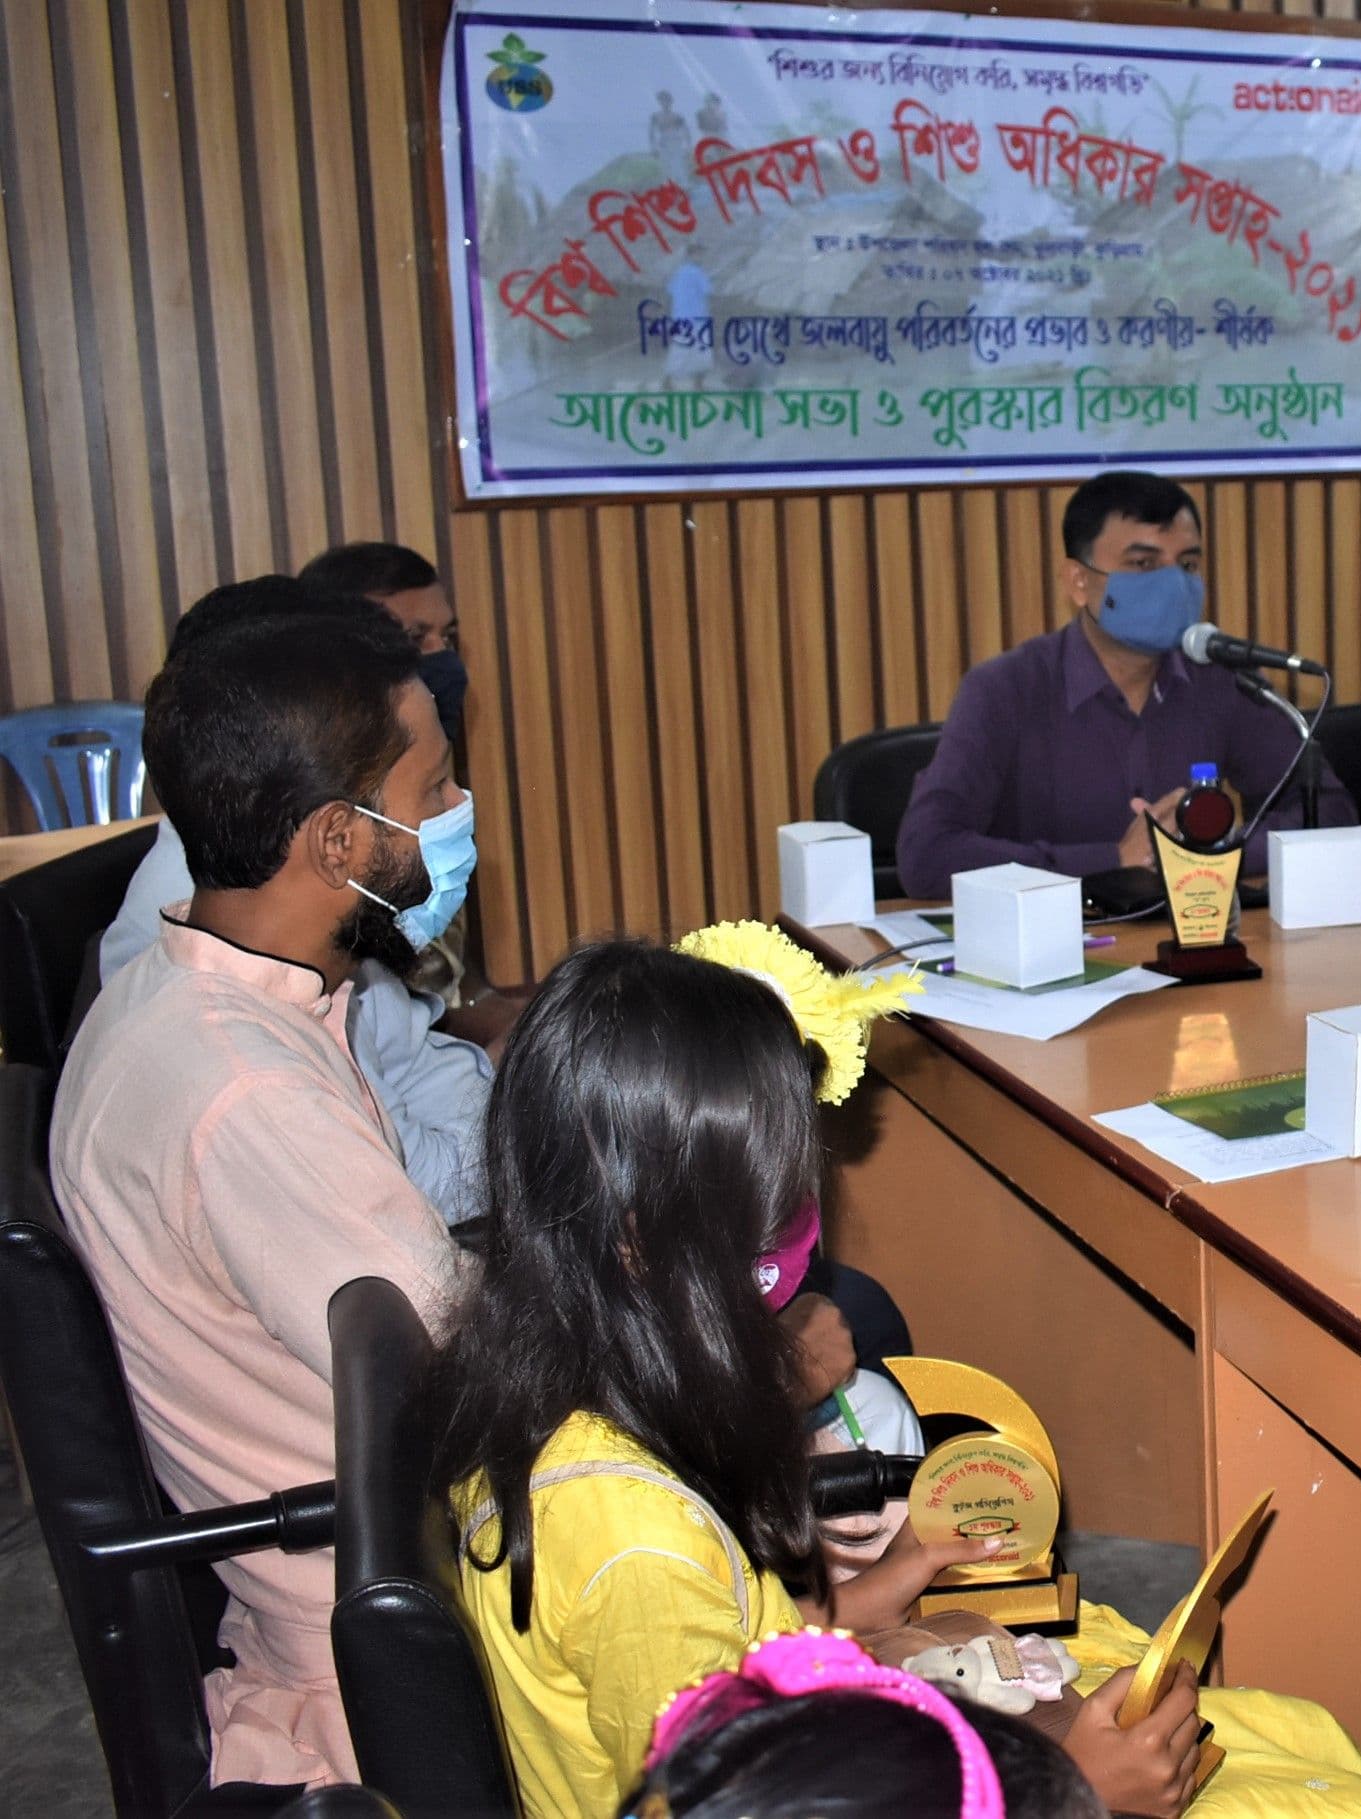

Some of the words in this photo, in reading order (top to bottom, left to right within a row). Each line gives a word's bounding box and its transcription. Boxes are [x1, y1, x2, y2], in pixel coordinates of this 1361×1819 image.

[499, 237, 620, 342] বিশ্ব
[588, 178, 698, 275] শিশু
[694, 135, 827, 226] দিবস
[837, 128, 881, 185] ও
[890, 98, 981, 187] শিশু
[994, 105, 1166, 207] অধিকার
[637, 298, 715, 356] শিশুর
[724, 315, 793, 366] চোখে
[799, 315, 896, 365] জলবায়ু
[896, 298, 1017, 364] পরিবর্তনের
[1024, 315, 1089, 352] প্রভাব
[1096, 315, 1112, 345] ও
[1212, 297, 1276, 352] শীর্ষক
[549, 390, 765, 457] আলোচনা
[772, 388, 862, 438] সভা
[873, 389, 905, 428] ও
[919, 385, 1065, 451] পুরস্কার
[1073, 365, 1200, 432] বিতরণ
[1211, 365, 1346, 442] অনুষ্ঠান
